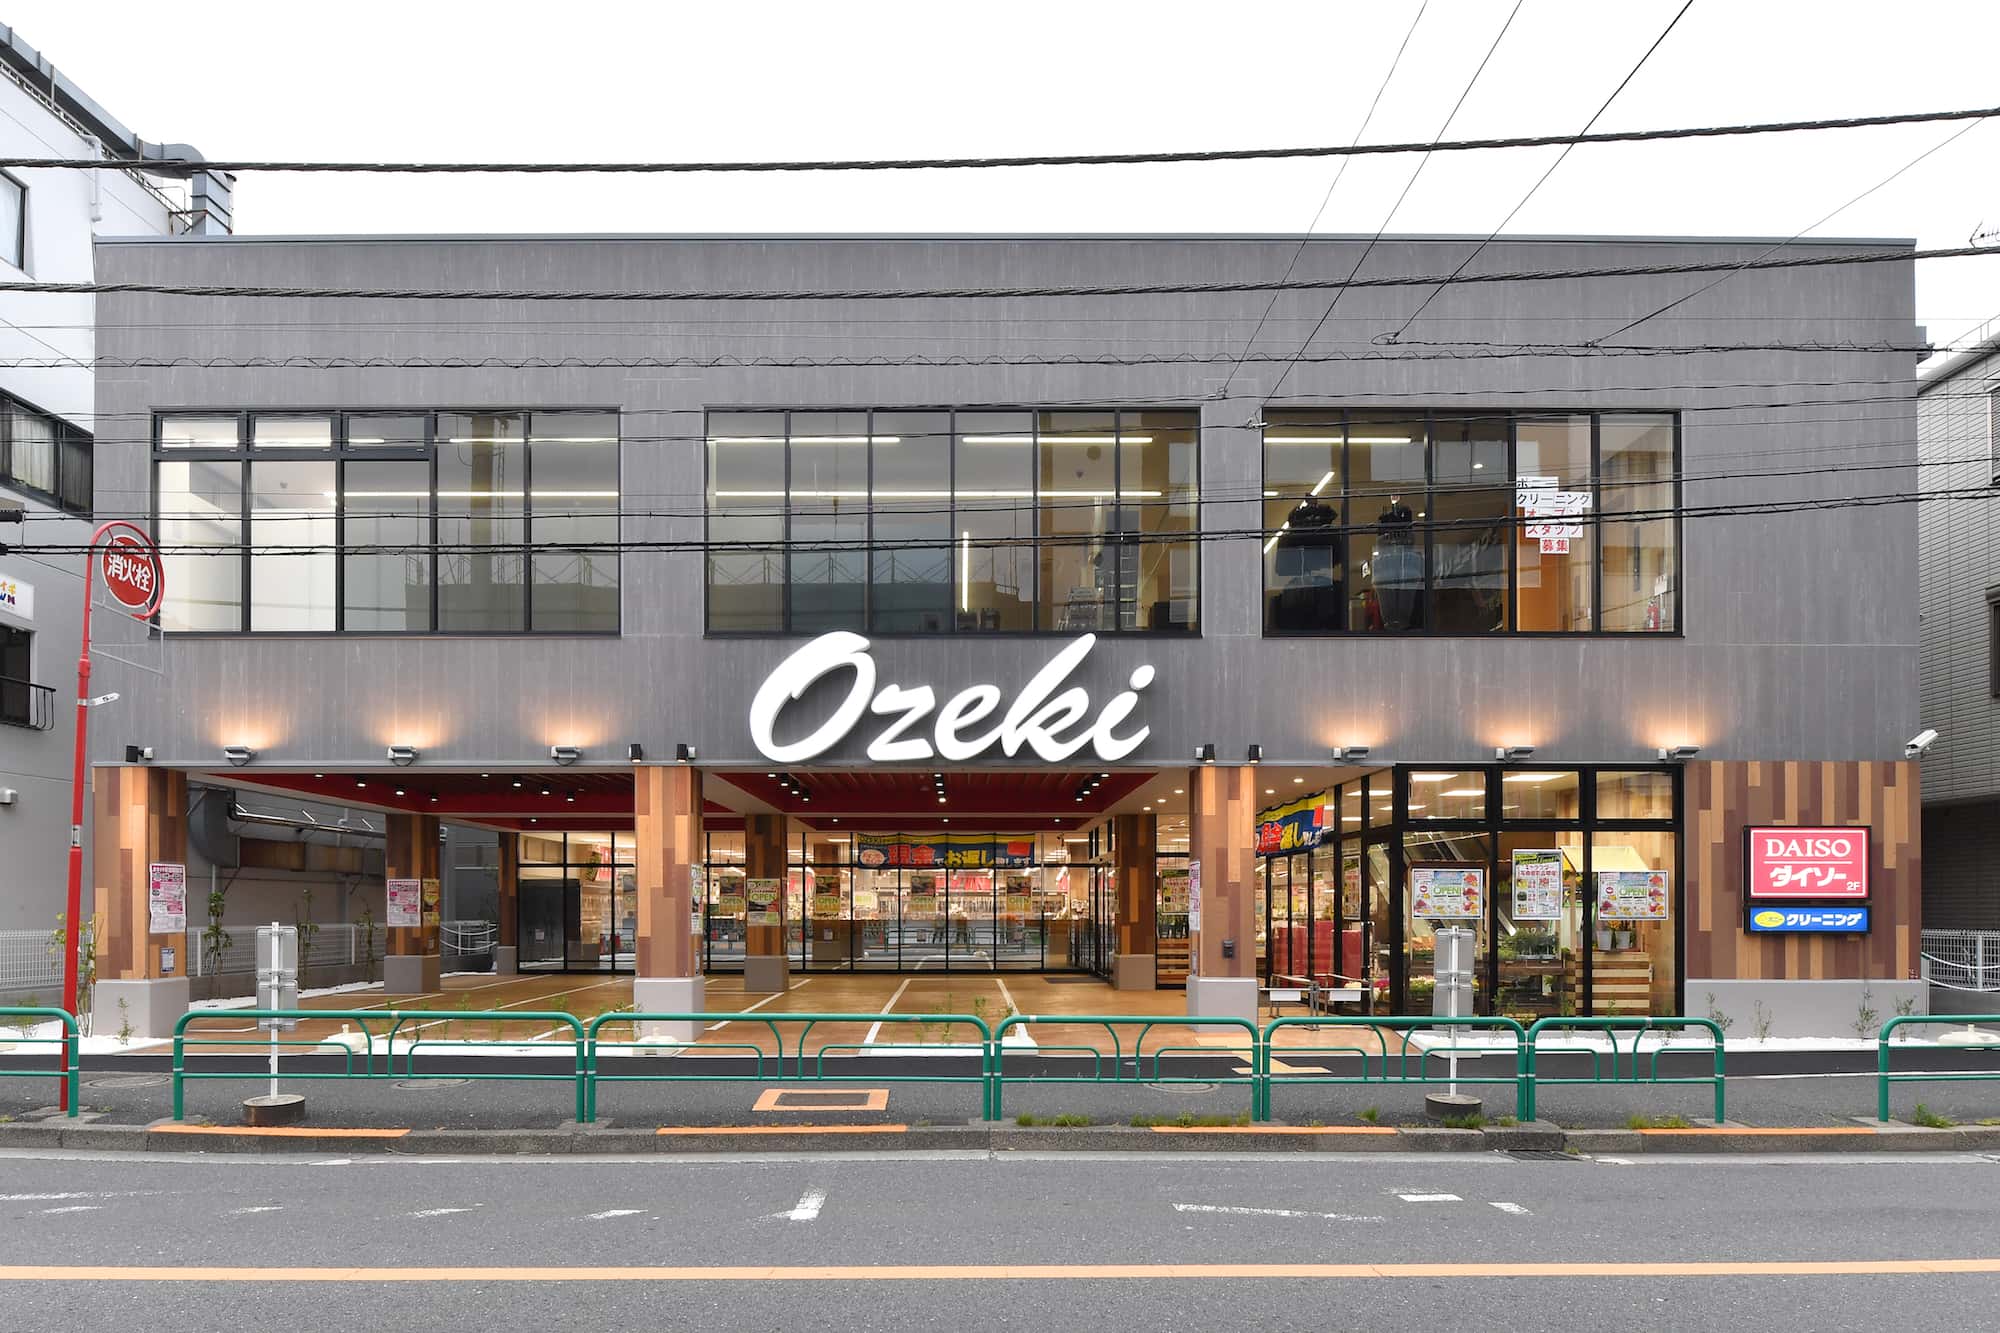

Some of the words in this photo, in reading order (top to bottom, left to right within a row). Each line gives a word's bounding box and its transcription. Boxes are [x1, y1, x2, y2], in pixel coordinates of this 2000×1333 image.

[1542, 539, 1569, 552] 募集
[107, 554, 151, 592] 消火栓
[749, 631, 1155, 763] Ozeki
[1765, 838, 1852, 858] DAISO
[1769, 865, 1847, 888] ダイソー
[1846, 881, 1862, 891] 2F
[751, 893, 776, 901] OPEN
[1786, 913, 1863, 926] クリーニング
